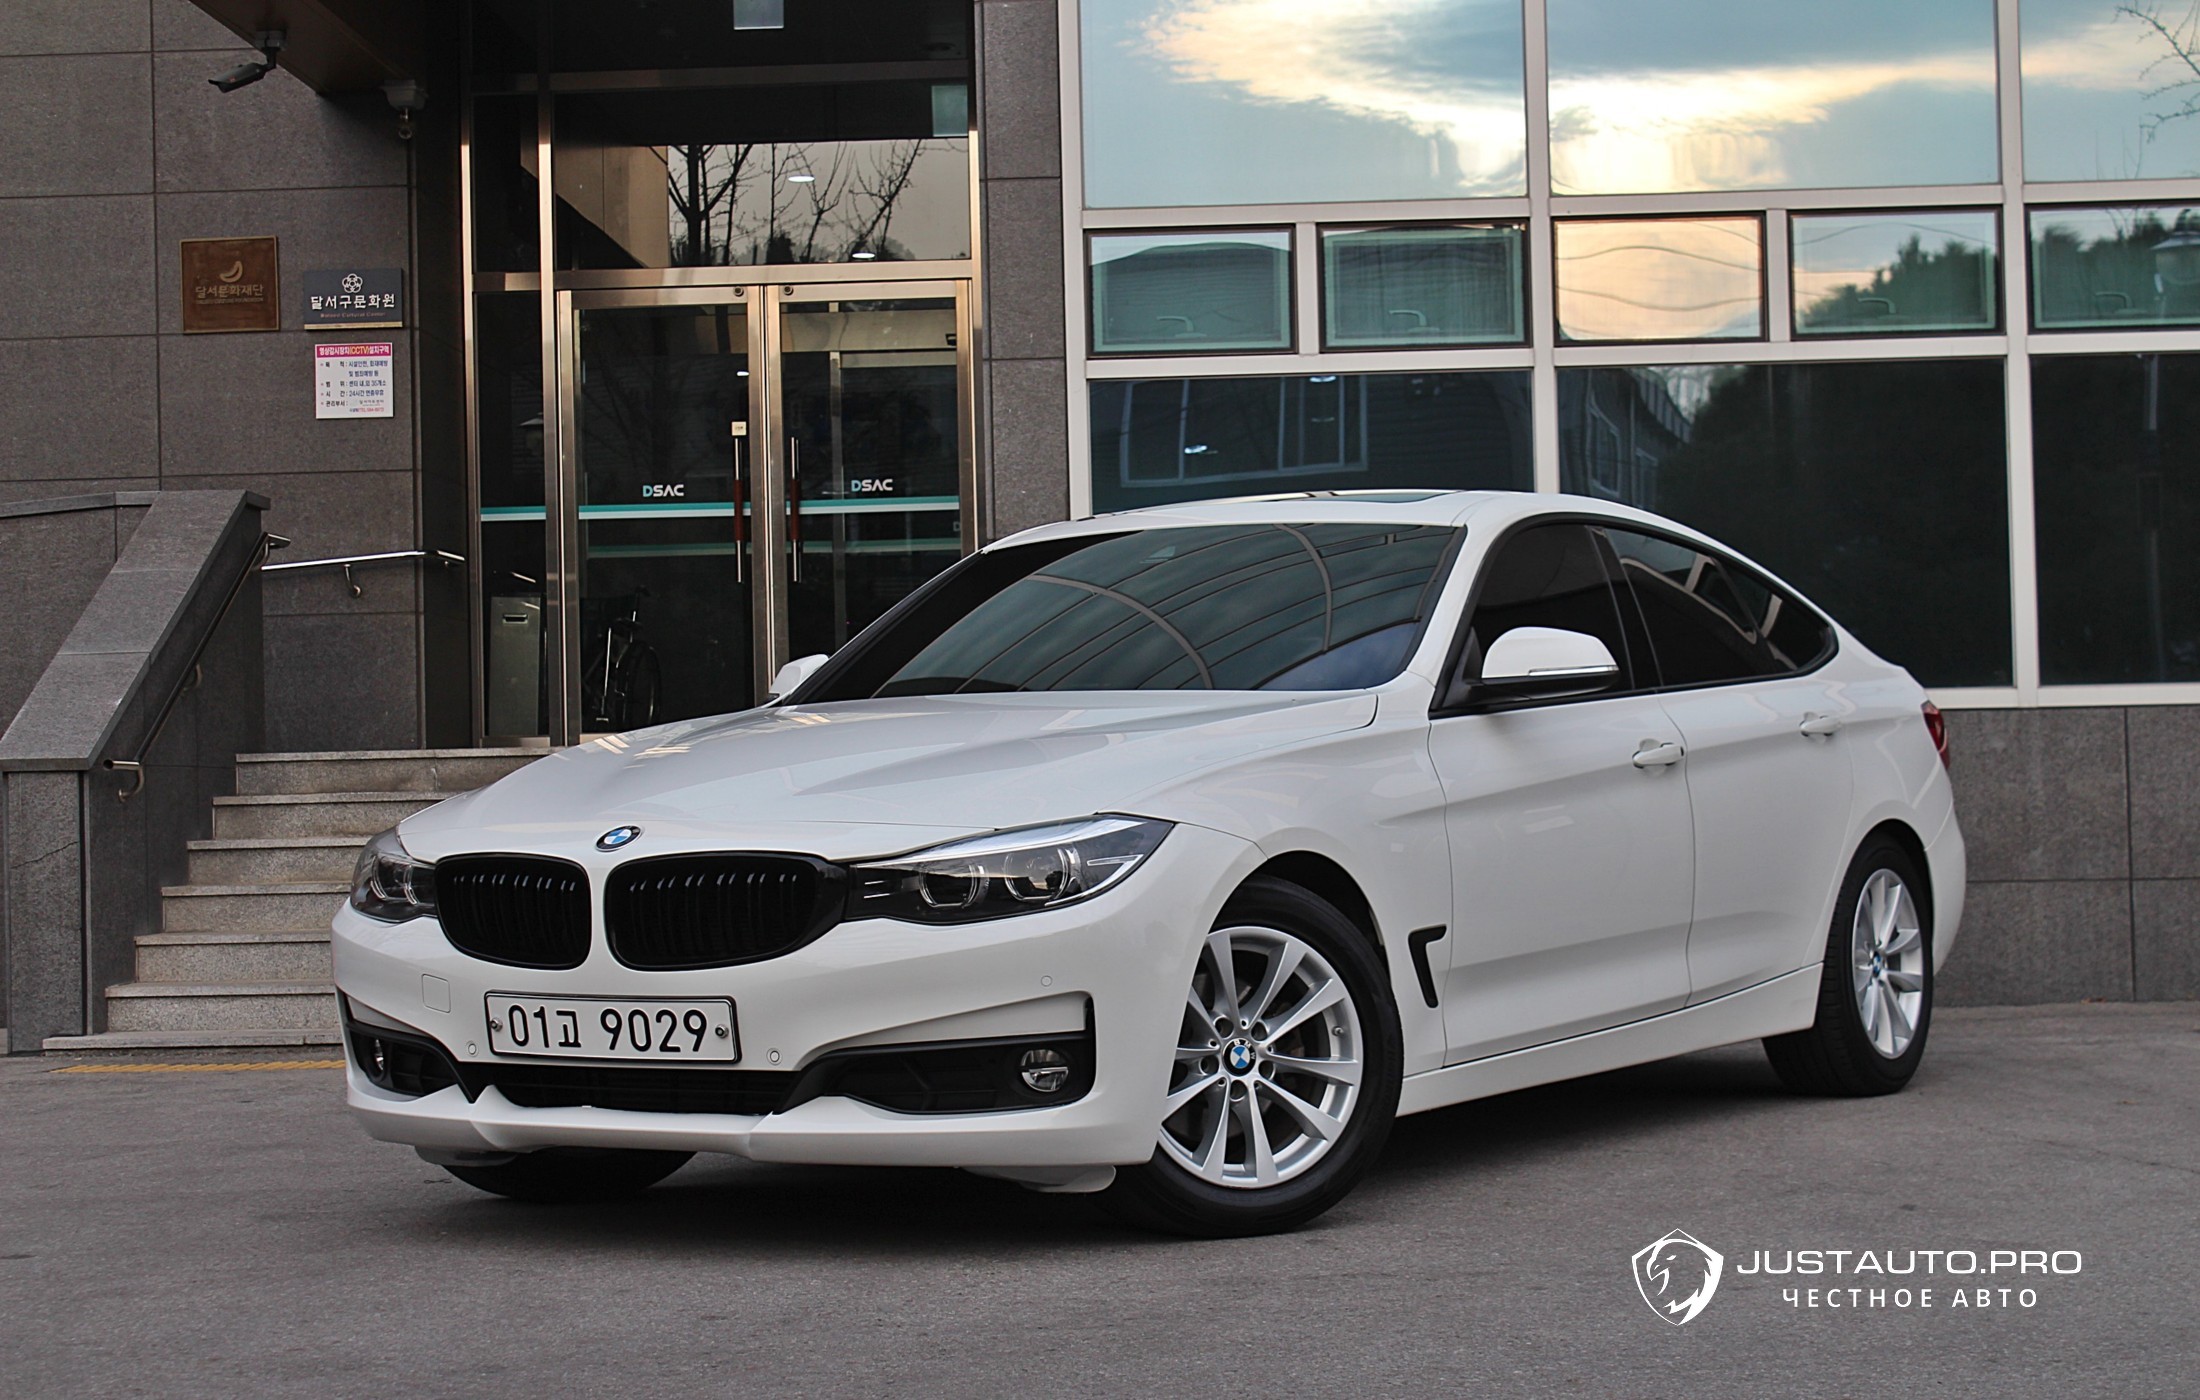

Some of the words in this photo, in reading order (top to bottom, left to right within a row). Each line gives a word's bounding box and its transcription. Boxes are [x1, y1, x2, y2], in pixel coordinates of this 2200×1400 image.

[195, 284, 264, 299] 달서문화재단
[310, 293, 395, 310] 달서구문화원
[642, 484, 684, 497] DSAC
[851, 479, 893, 492] DSAC
[508, 1004, 581, 1048] 01고
[600, 1008, 707, 1053] 9029
